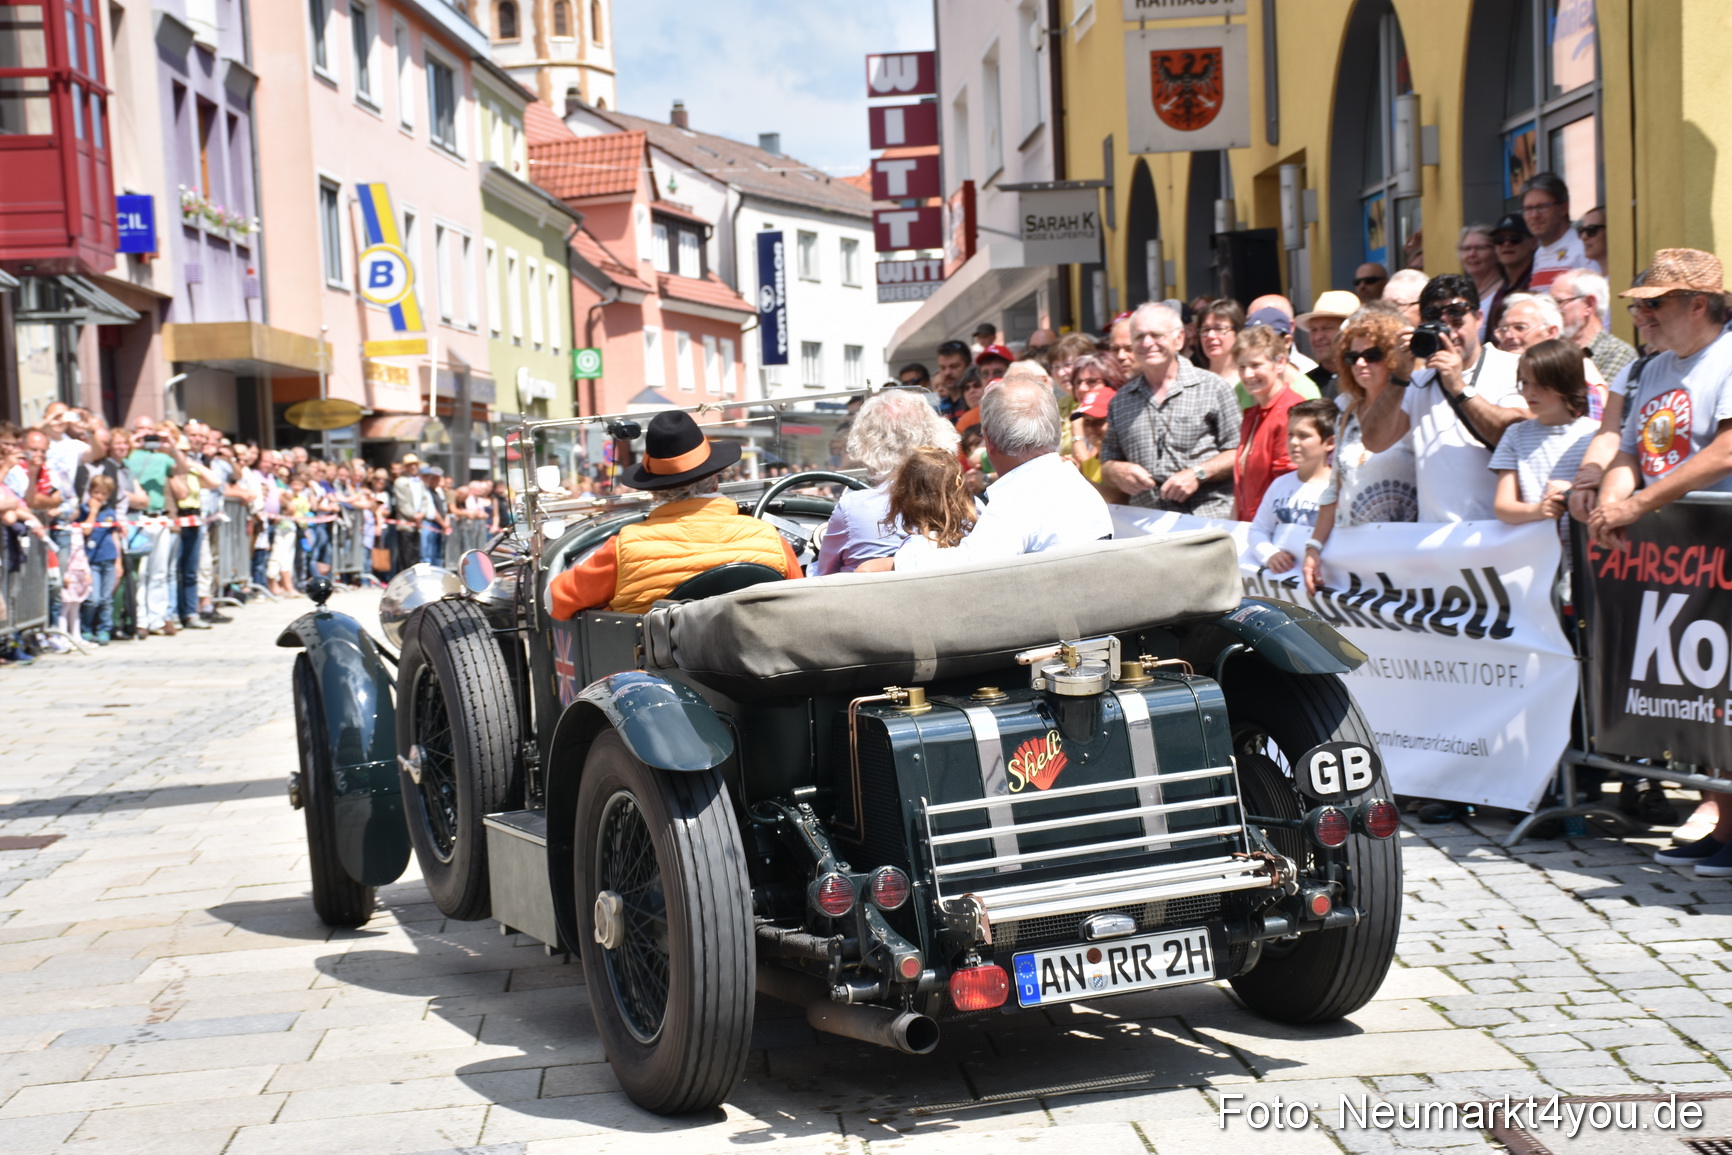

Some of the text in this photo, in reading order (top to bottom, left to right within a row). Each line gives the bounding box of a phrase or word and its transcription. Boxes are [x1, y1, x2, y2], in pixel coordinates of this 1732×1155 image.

[1025, 211, 1094, 232] SARAH K
[368, 260, 394, 288] B
[773, 241, 785, 307] TAILOR
[878, 260, 941, 283] WITT
[1641, 449, 1680, 473] 1758
[1630, 590, 1732, 691] Ko
[1367, 656, 1524, 689] NEUMARKT/OPF.
[1625, 687, 1716, 724] Neumarkt
[1373, 729, 1489, 757] om/neumarktaktuell
[1008, 729, 1063, 793] Shell
[1310, 746, 1373, 795] GB
[1041, 935, 1211, 996] AN RR 2H
[1025, 984, 1035, 996] D
